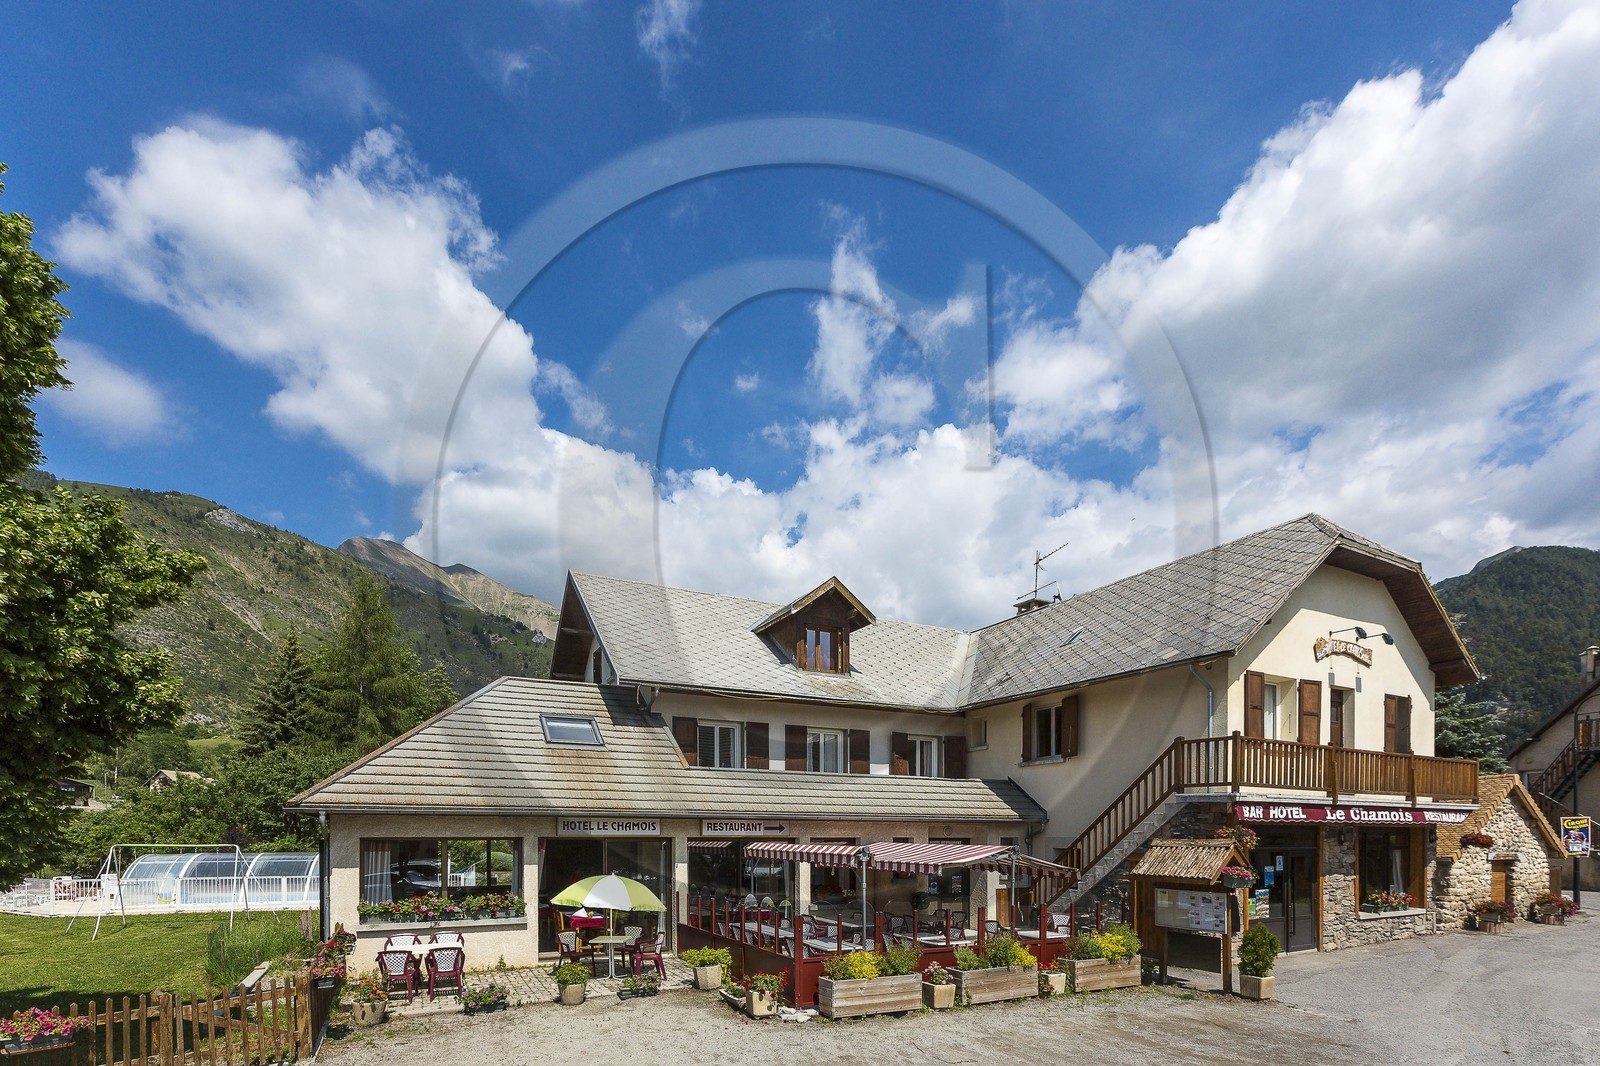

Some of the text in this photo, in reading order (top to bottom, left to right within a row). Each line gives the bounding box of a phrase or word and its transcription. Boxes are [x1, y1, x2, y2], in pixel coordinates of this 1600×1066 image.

[1242, 804, 1263, 819] BAR
[1269, 805, 1307, 819] HOTEL
[1324, 807, 1346, 820] Le
[1350, 808, 1413, 822] Chamois
[562, 820, 657, 831] HOTEL LE CHAMOIS
[706, 822, 763, 832] RESTAURANT
